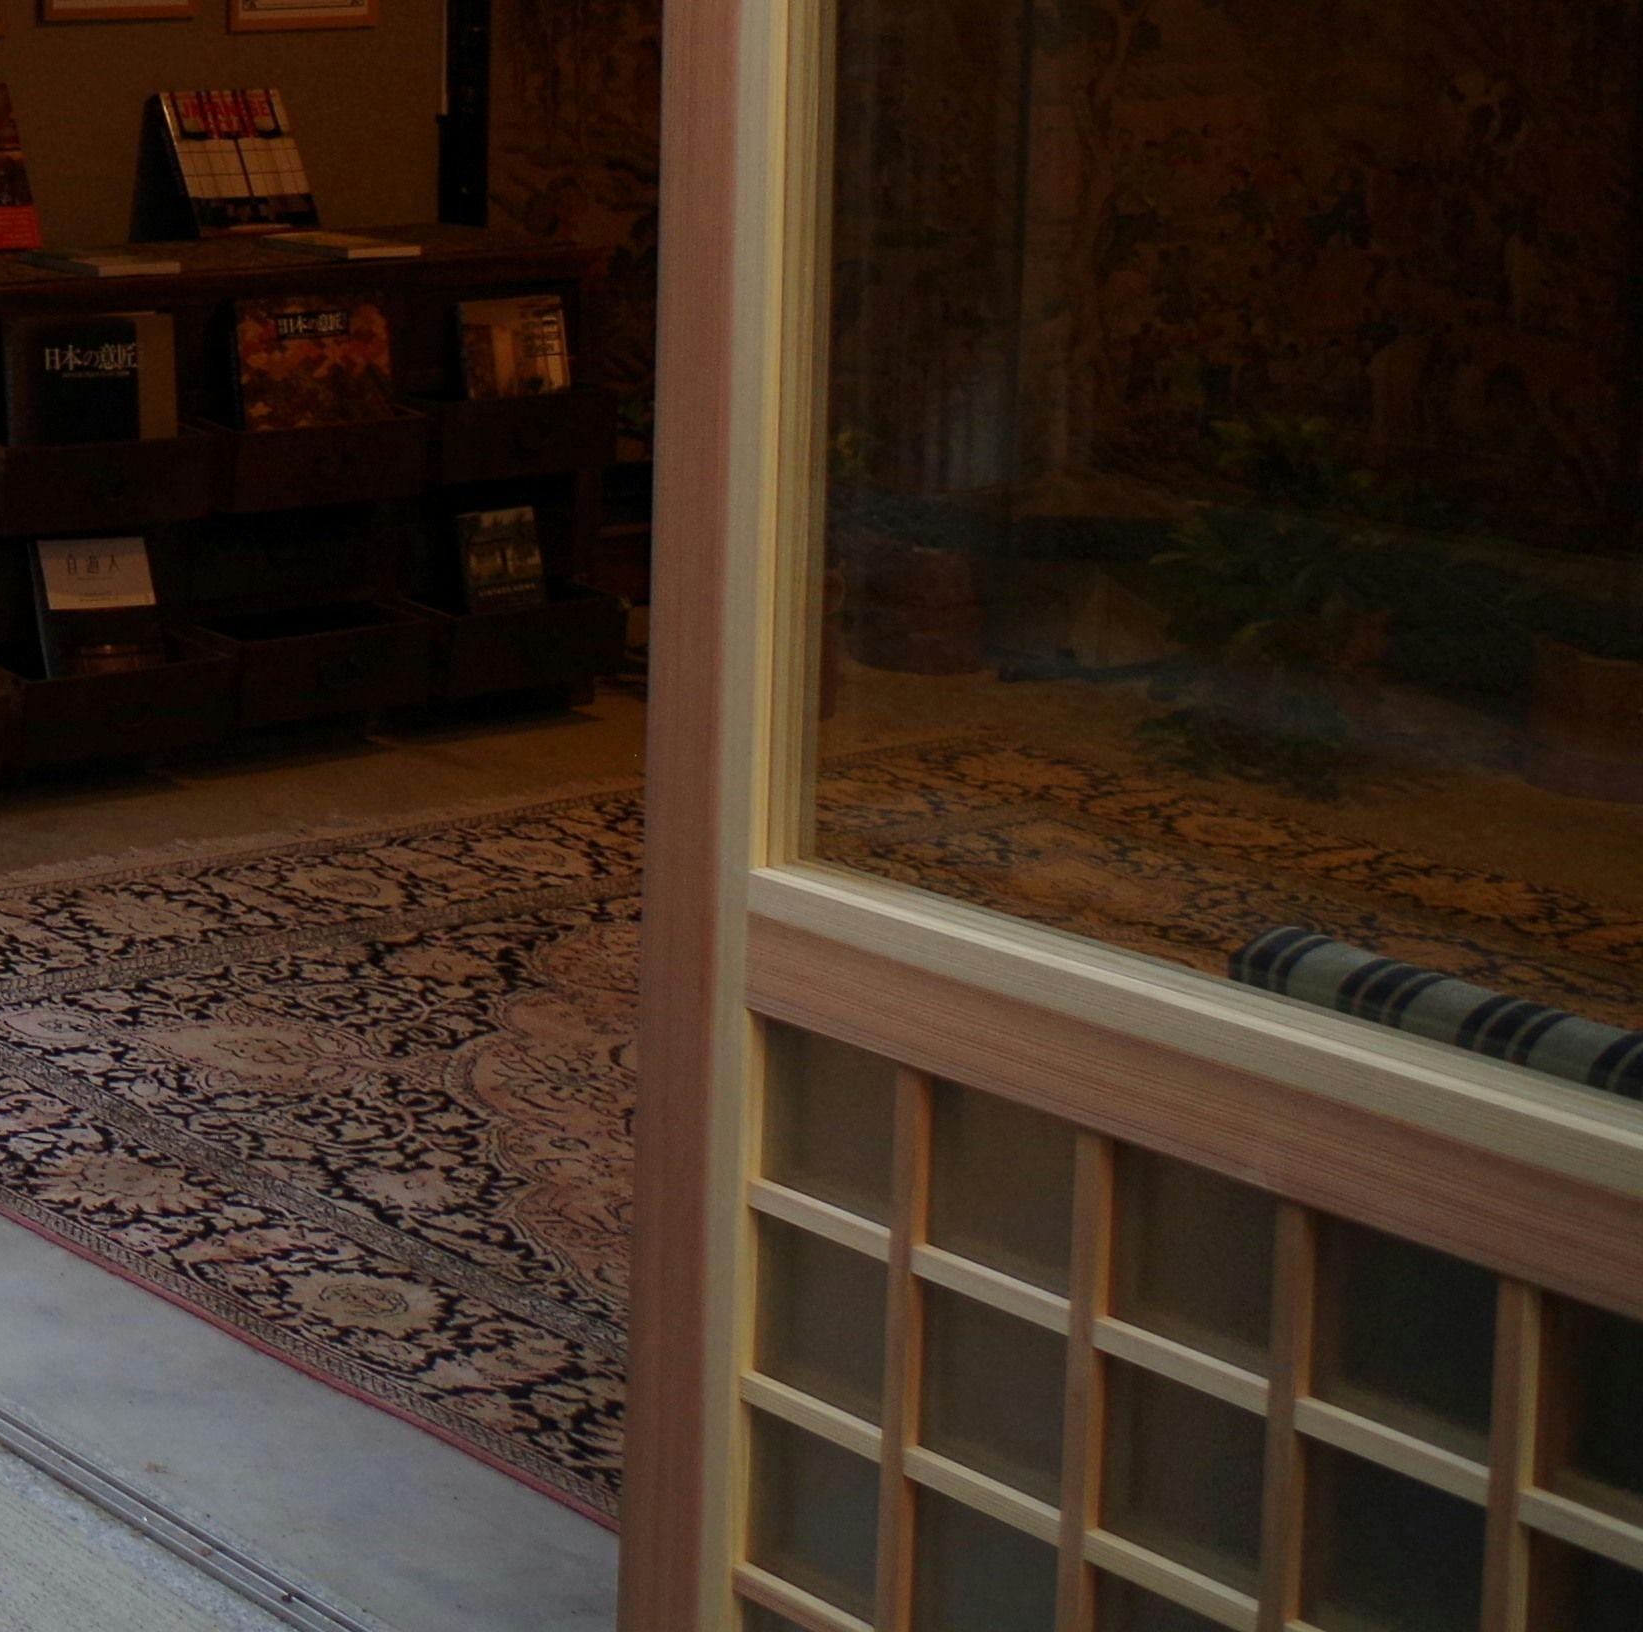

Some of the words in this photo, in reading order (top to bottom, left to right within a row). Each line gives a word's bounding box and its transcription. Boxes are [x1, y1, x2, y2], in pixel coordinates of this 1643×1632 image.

[44, 343, 137, 371] 日本の意匠
